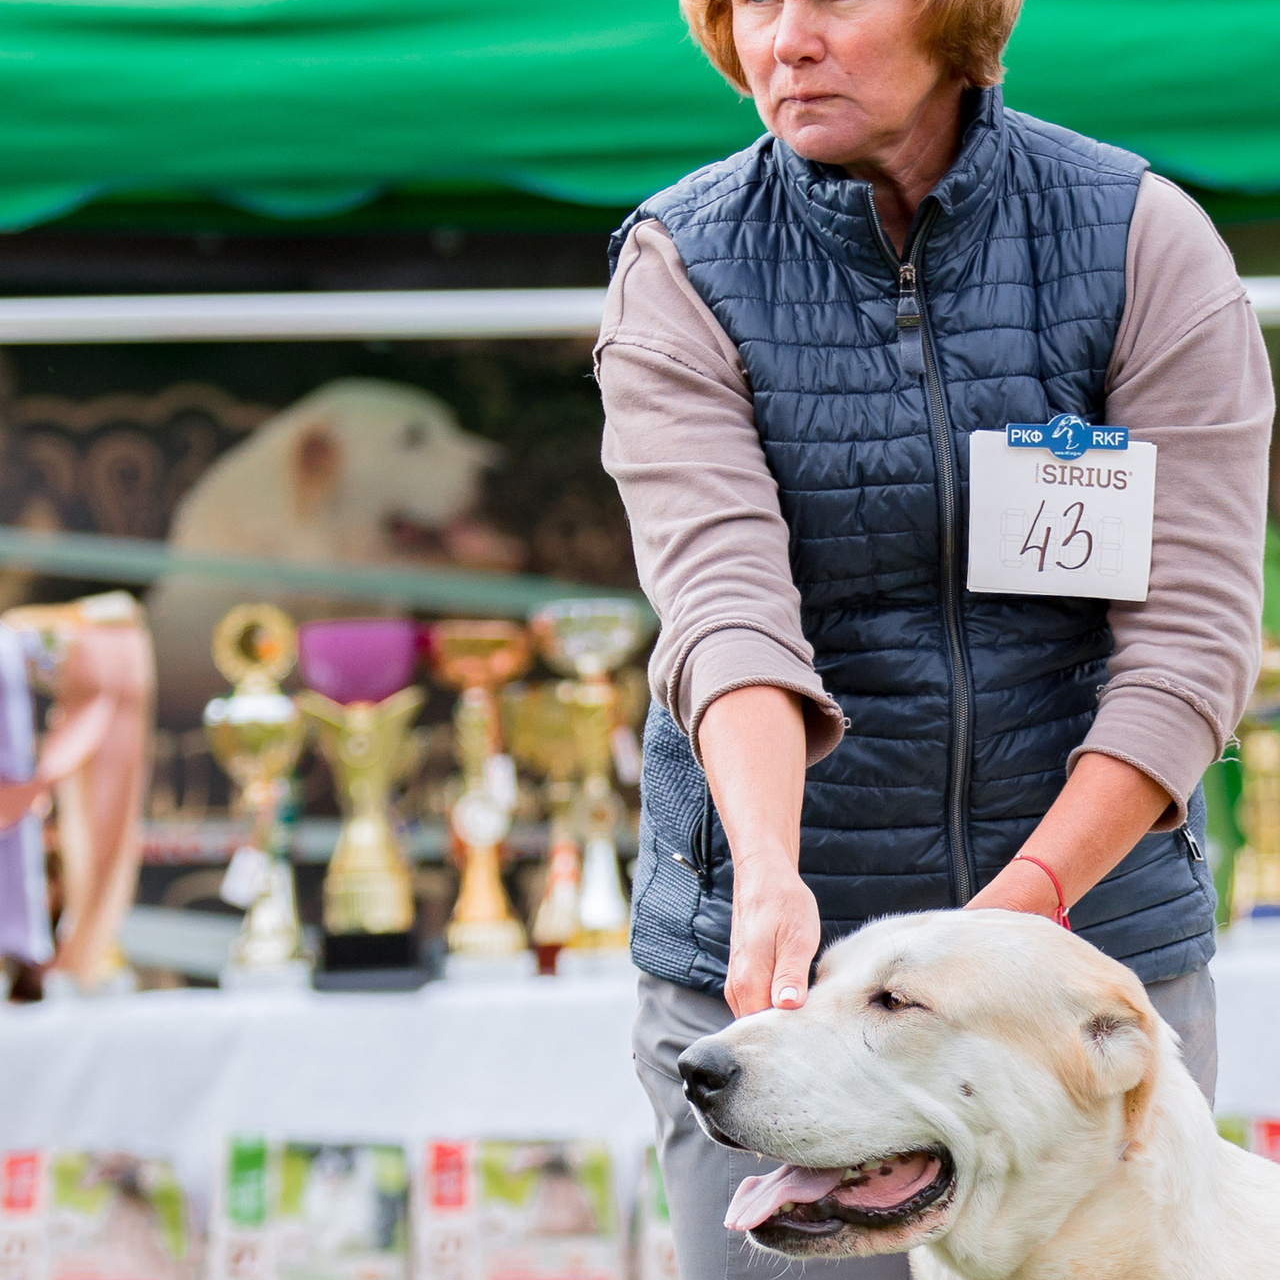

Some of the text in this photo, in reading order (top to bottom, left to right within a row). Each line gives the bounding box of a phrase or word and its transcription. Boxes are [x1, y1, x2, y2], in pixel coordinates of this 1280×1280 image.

[1011, 429, 1044, 444] РКФ
[1092, 431, 1126, 446] RKF
[1042, 464, 1128, 491] SIRIUS
[1019, 499, 1093, 573] 43
